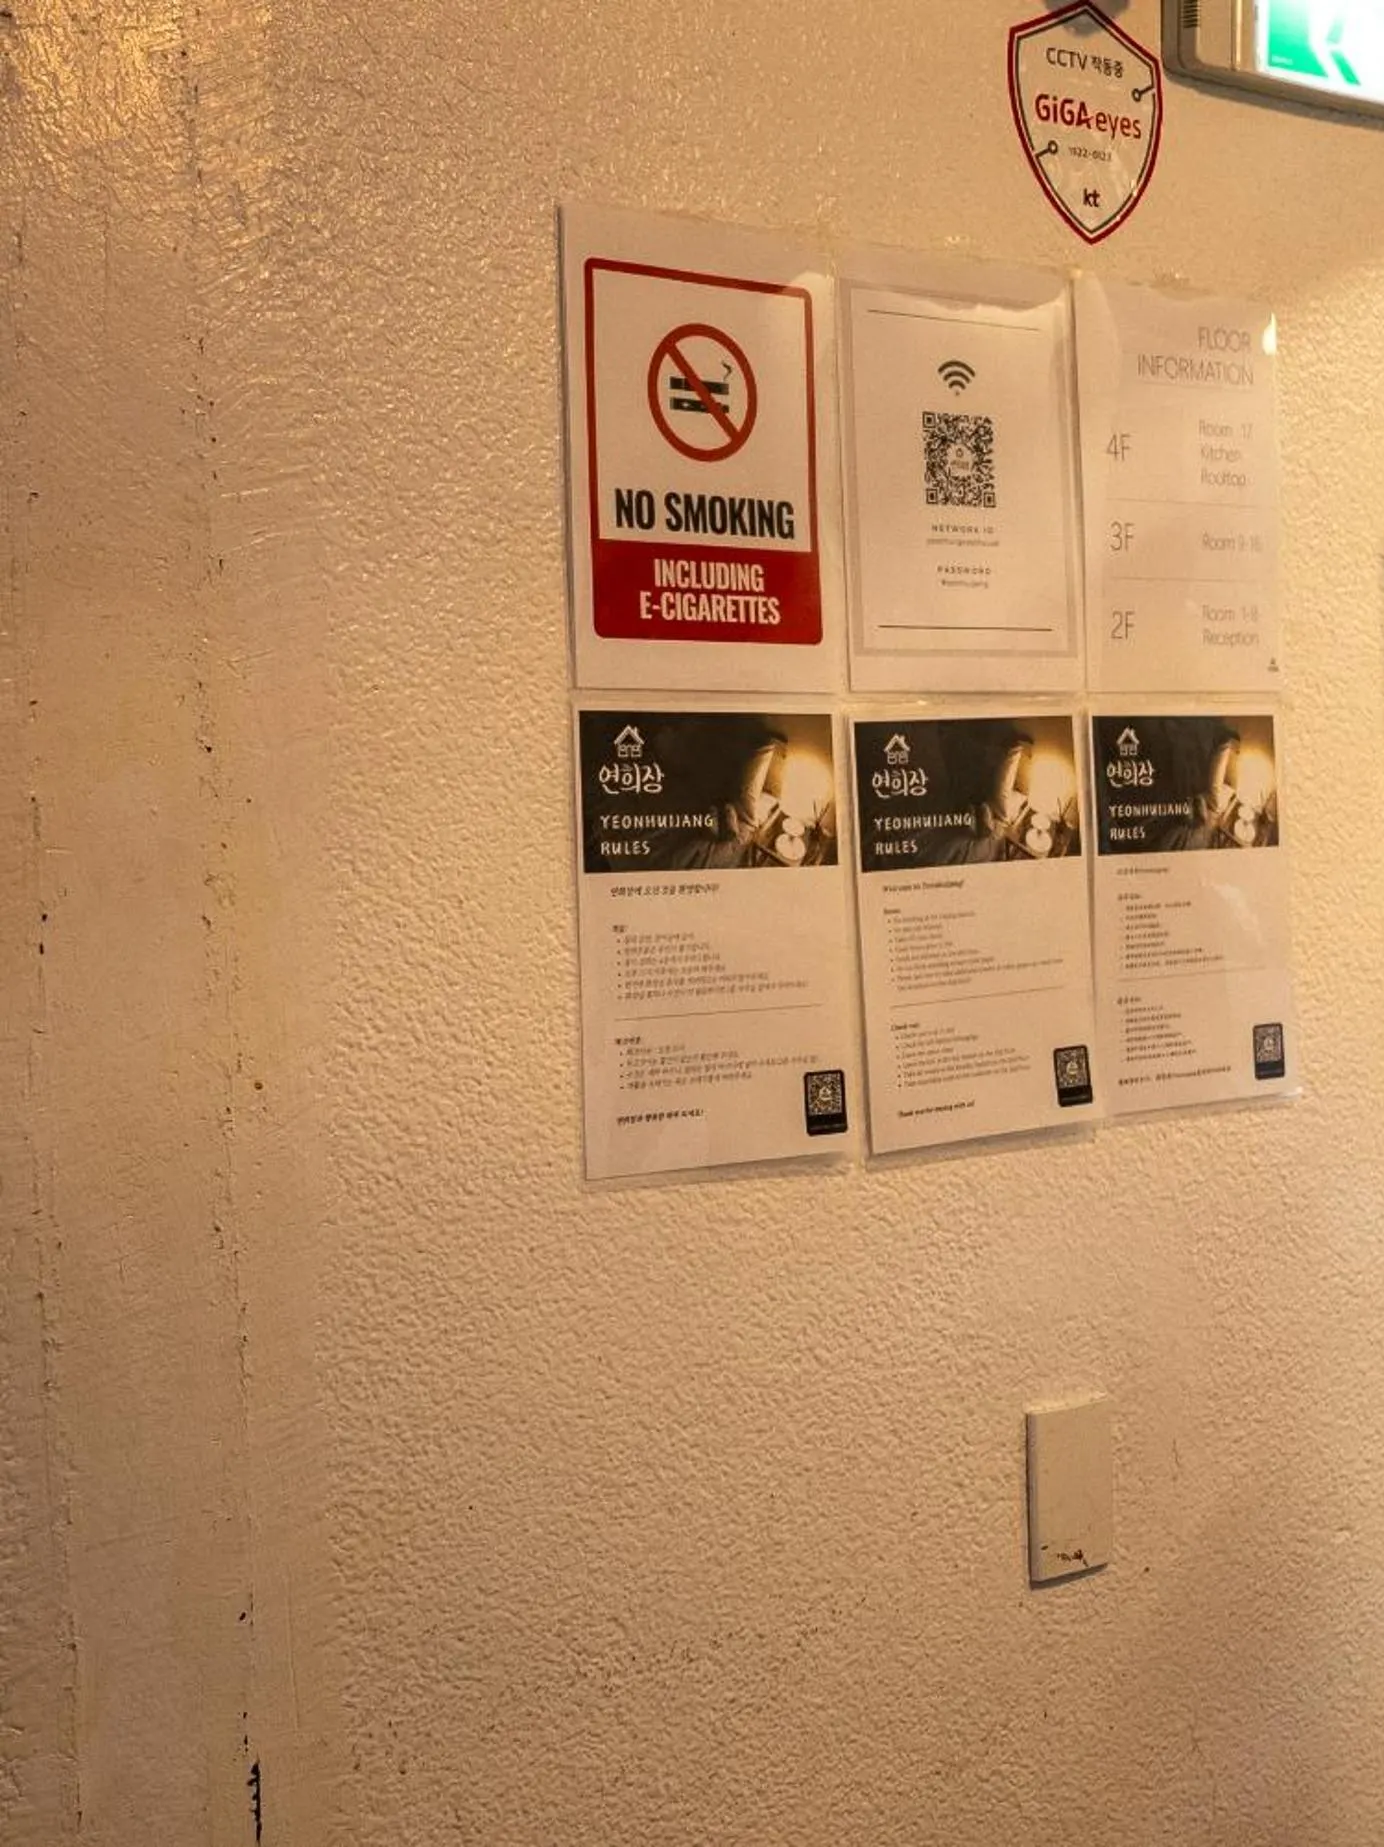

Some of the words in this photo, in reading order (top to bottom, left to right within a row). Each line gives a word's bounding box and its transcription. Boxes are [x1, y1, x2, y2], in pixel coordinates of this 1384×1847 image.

[1046, 47, 1087, 70] CCTV
[1091, 56, 1124, 78] 작동중
[1083, 188, 1100, 207] kt
[1198, 326, 1251, 353] FLOOR
[1138, 354, 1254, 385] INFORMATION
[1199, 419, 1233, 437] Room
[1106, 433, 1132, 461] 4F
[614, 487, 655, 531] NO
[665, 493, 795, 540] SMOKING
[1110, 520, 1136, 551] 3F
[1202, 531, 1235, 551] Room
[654, 558, 765, 592] INCLUDING
[639, 590, 781, 626] E-CIGARETTES
[1202, 604, 1236, 621] Room
[1110, 610, 1136, 640] 2F
[1203, 628, 1260, 648] Reception
[599, 762, 665, 794] 연희장
[872, 768, 929, 799] 연희장
[1106, 759, 1155, 788] 연희장
[600, 814, 715, 830] YEONHUIJANG
[874, 812, 973, 832] YEONHUIJANG
[1109, 802, 1191, 818] YEONHUIJANG
[1110, 826, 1146, 841] RULES
[600, 840, 651, 857] RULES
[875, 839, 919, 856] RULES
